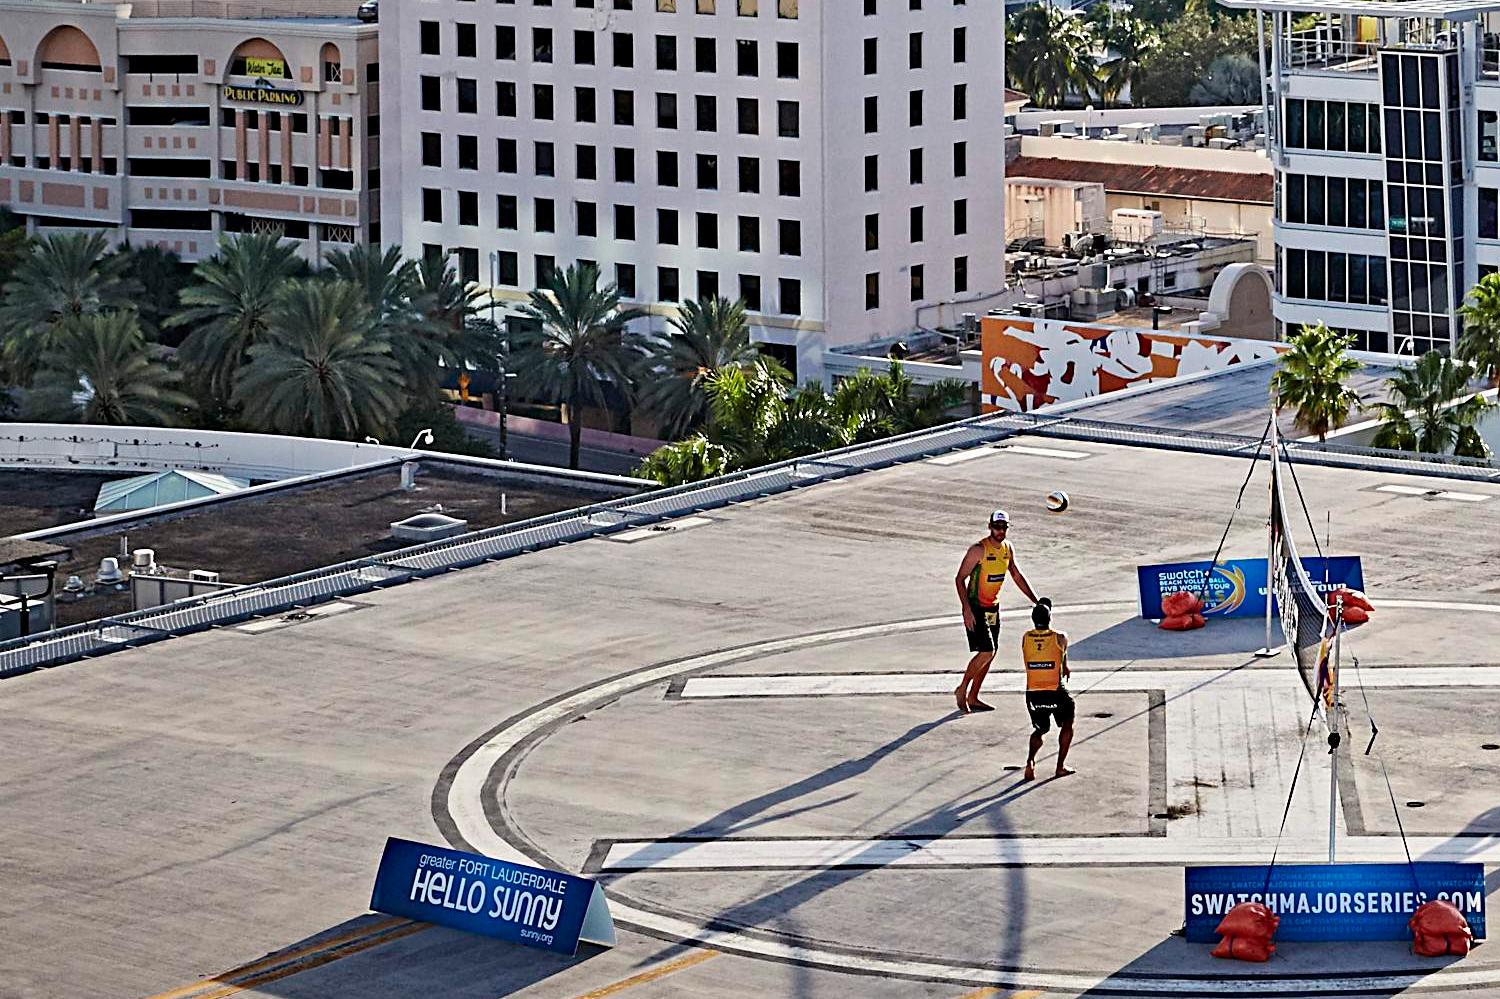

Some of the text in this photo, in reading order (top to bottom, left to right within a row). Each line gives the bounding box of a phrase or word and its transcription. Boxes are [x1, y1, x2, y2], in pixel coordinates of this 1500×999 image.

[225, 87, 296, 104] PUBLIC PARKING
[1159, 569, 1203, 581] swatch
[419, 854, 568, 895] greater FORT LAUDERDALE
[1191, 891, 1482, 915] SWATHMAJORSERIESOM
[520, 928, 554, 944] sunny.org
